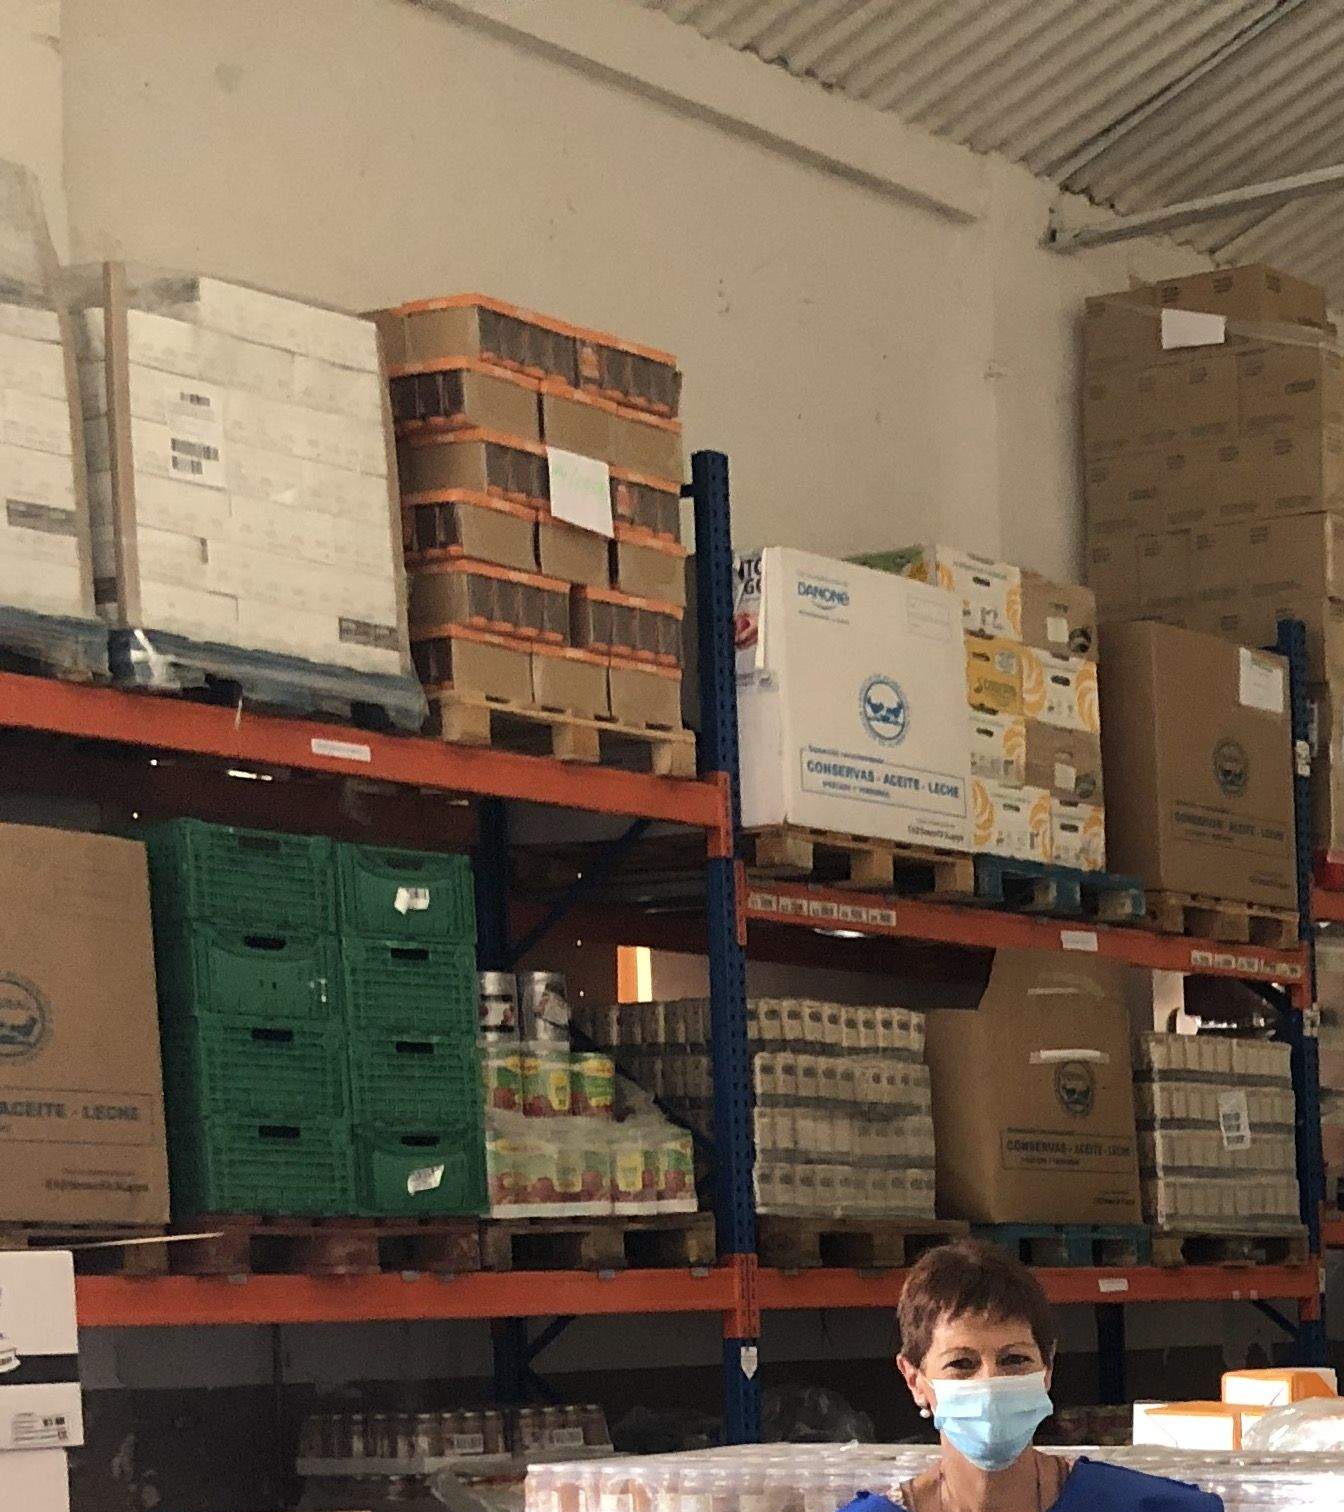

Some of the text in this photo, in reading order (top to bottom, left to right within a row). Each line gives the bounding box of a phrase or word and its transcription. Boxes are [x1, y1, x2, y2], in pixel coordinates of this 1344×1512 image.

[806, 759, 875, 783] CONSERVAS
[883, 773, 920, 791] ACEITE
[927, 782, 960, 799] LECHE
